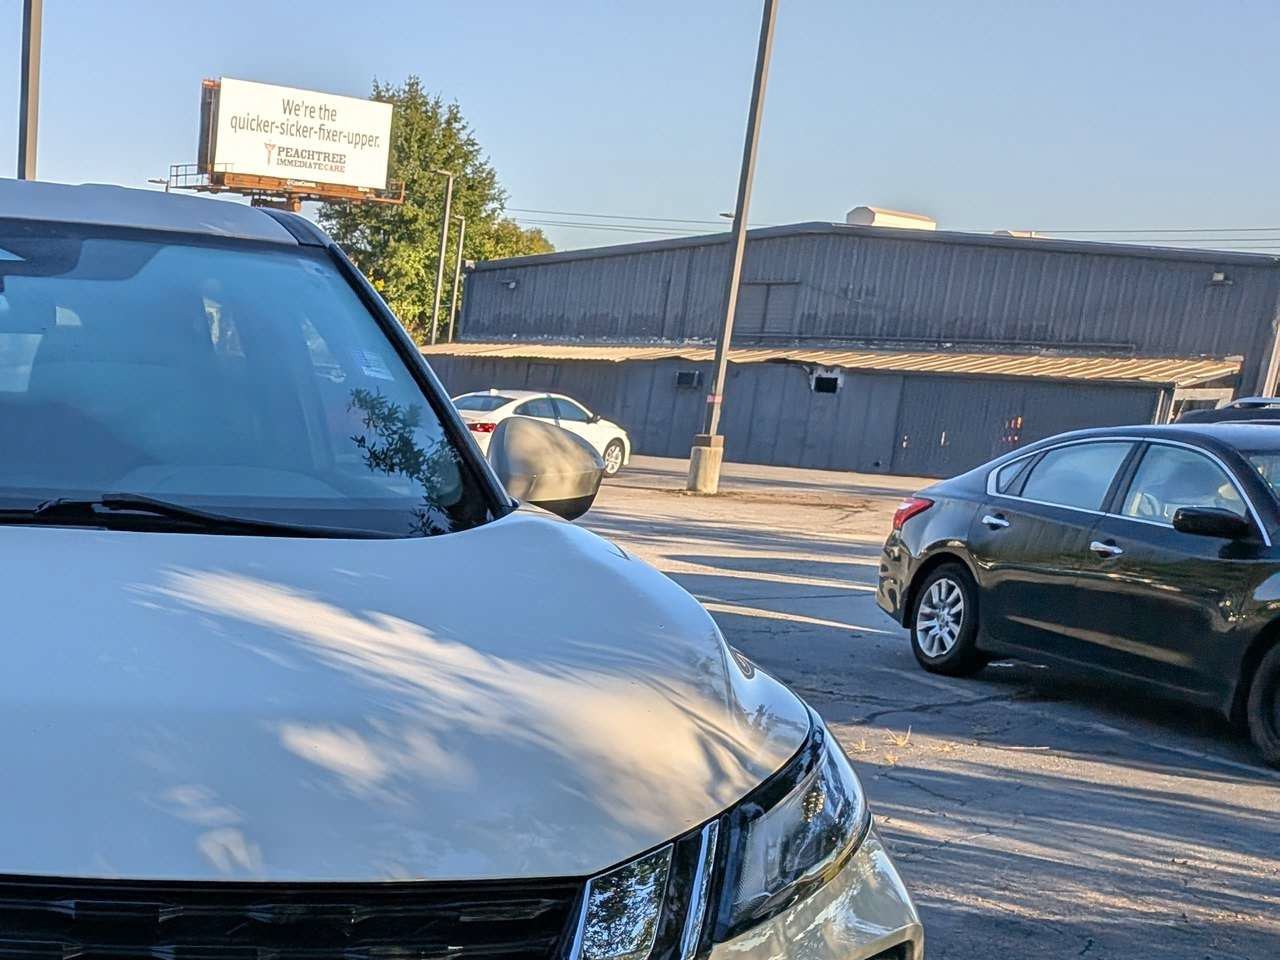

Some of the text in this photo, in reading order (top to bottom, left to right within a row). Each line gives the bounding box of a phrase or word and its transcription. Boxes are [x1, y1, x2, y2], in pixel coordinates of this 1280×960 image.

[282, 98, 337, 122] We're the
[230, 112, 380, 150] quicker-sicker-fixer-upper.
[277, 146, 346, 164] PEACHTREE
